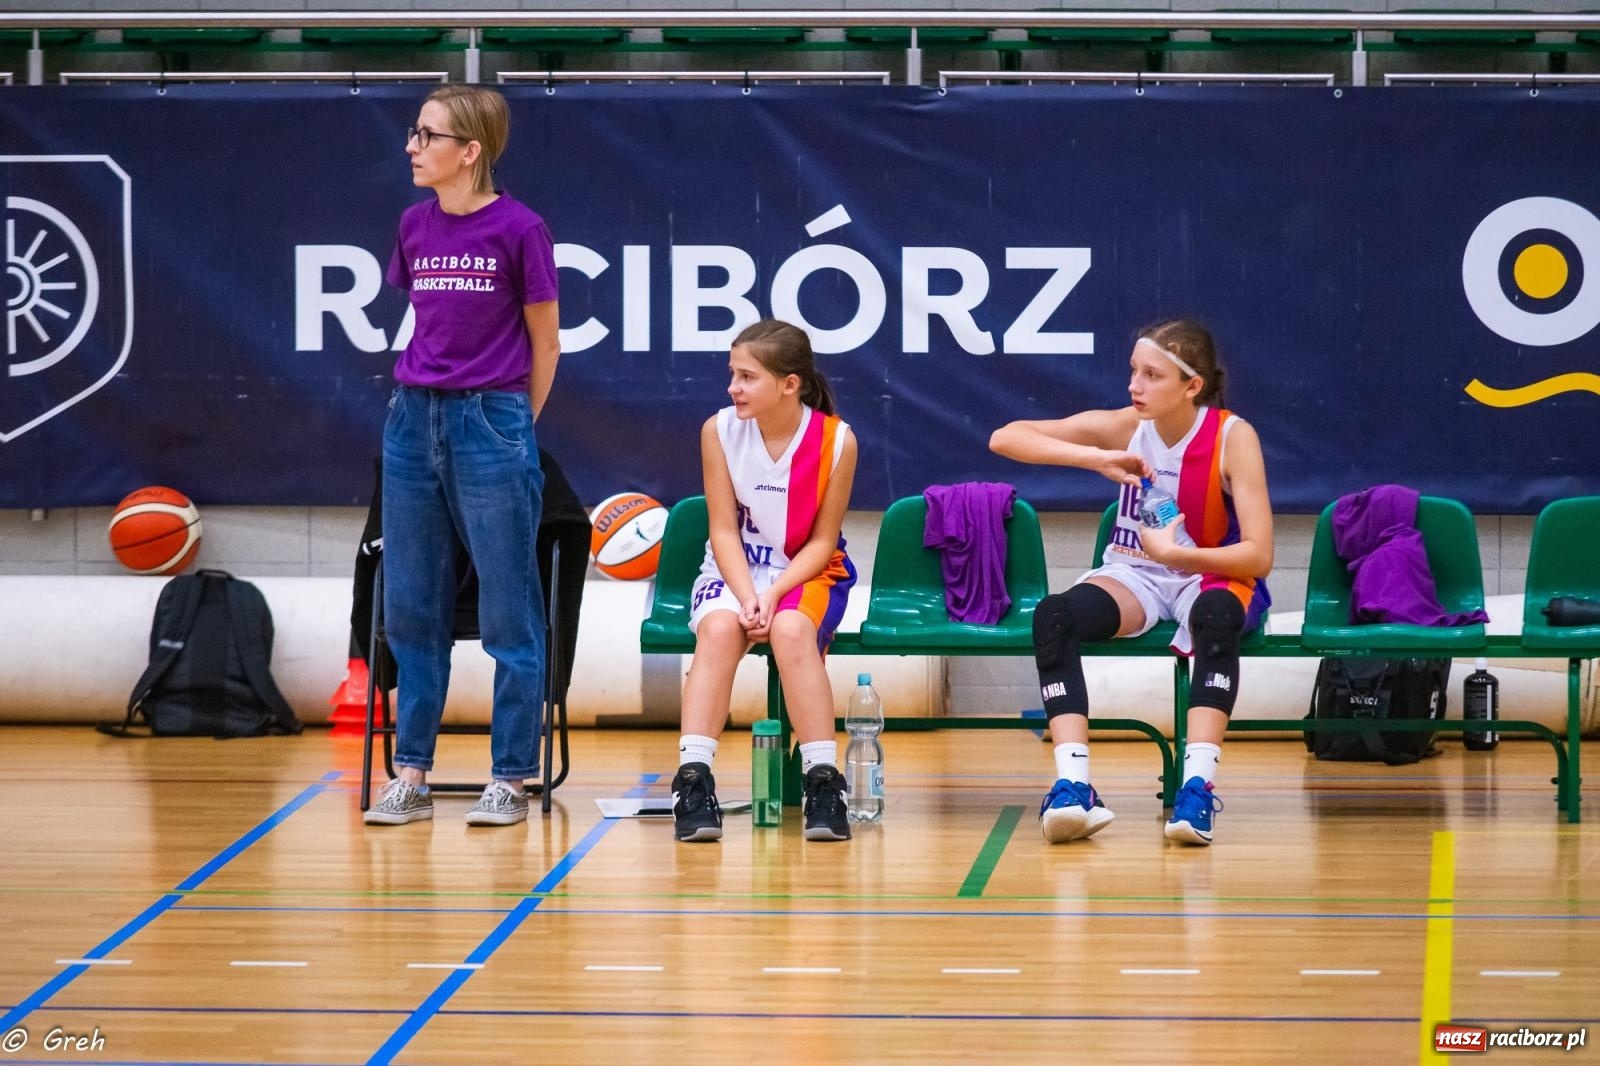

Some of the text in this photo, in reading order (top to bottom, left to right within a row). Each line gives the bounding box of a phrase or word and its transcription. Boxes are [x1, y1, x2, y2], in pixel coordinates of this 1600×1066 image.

[413, 253, 497, 271] RACIBÓRZ
[294, 203, 1095, 355] RCIBÓRZ
[412, 277, 495, 292] BASKETBALL
[1109, 526, 1144, 552] MIN
[744, 542, 774, 565] NI
[1047, 682, 1067, 699] NBA
